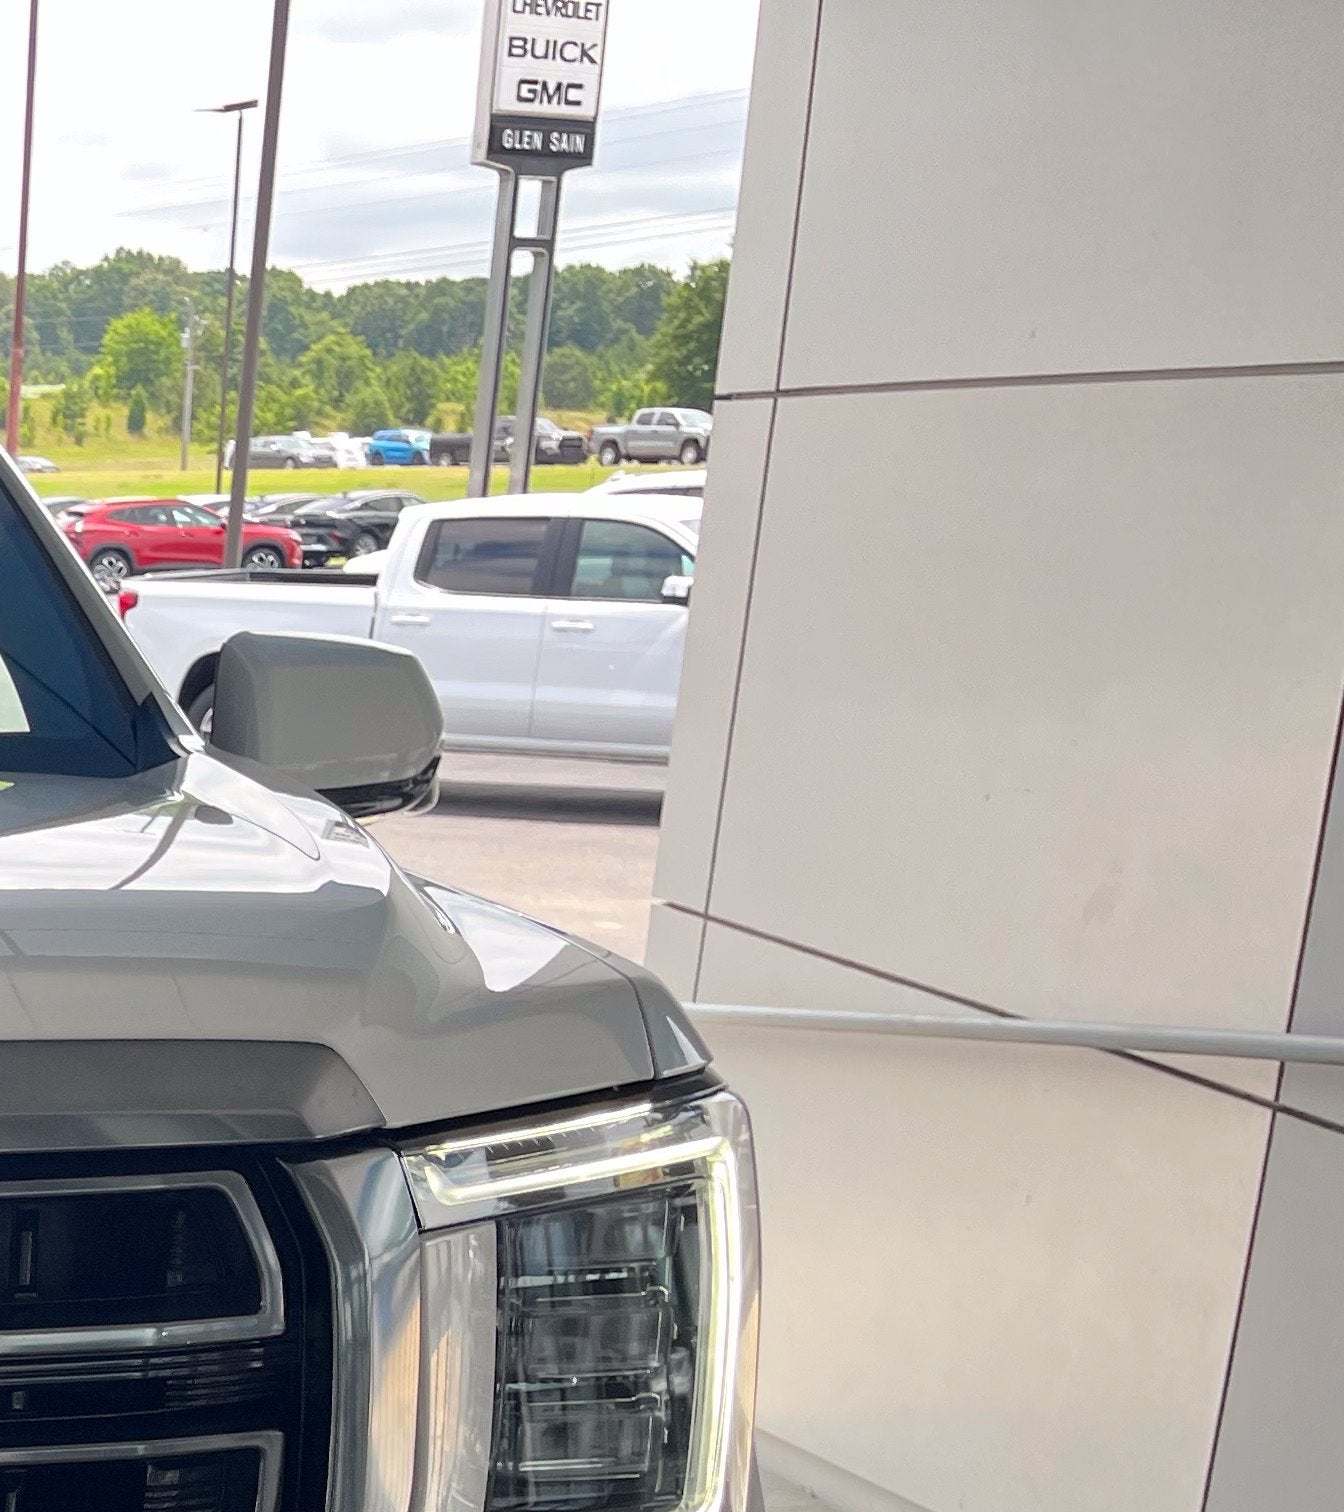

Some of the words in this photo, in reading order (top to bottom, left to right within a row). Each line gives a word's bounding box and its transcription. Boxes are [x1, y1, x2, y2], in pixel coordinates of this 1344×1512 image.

[512, 0, 602, 21] CHEVROLET
[507, 36, 598, 64] BUICK
[517, 78, 584, 106] GMC
[502, 128, 543, 151] GLEN
[549, 131, 586, 154] SAIN
